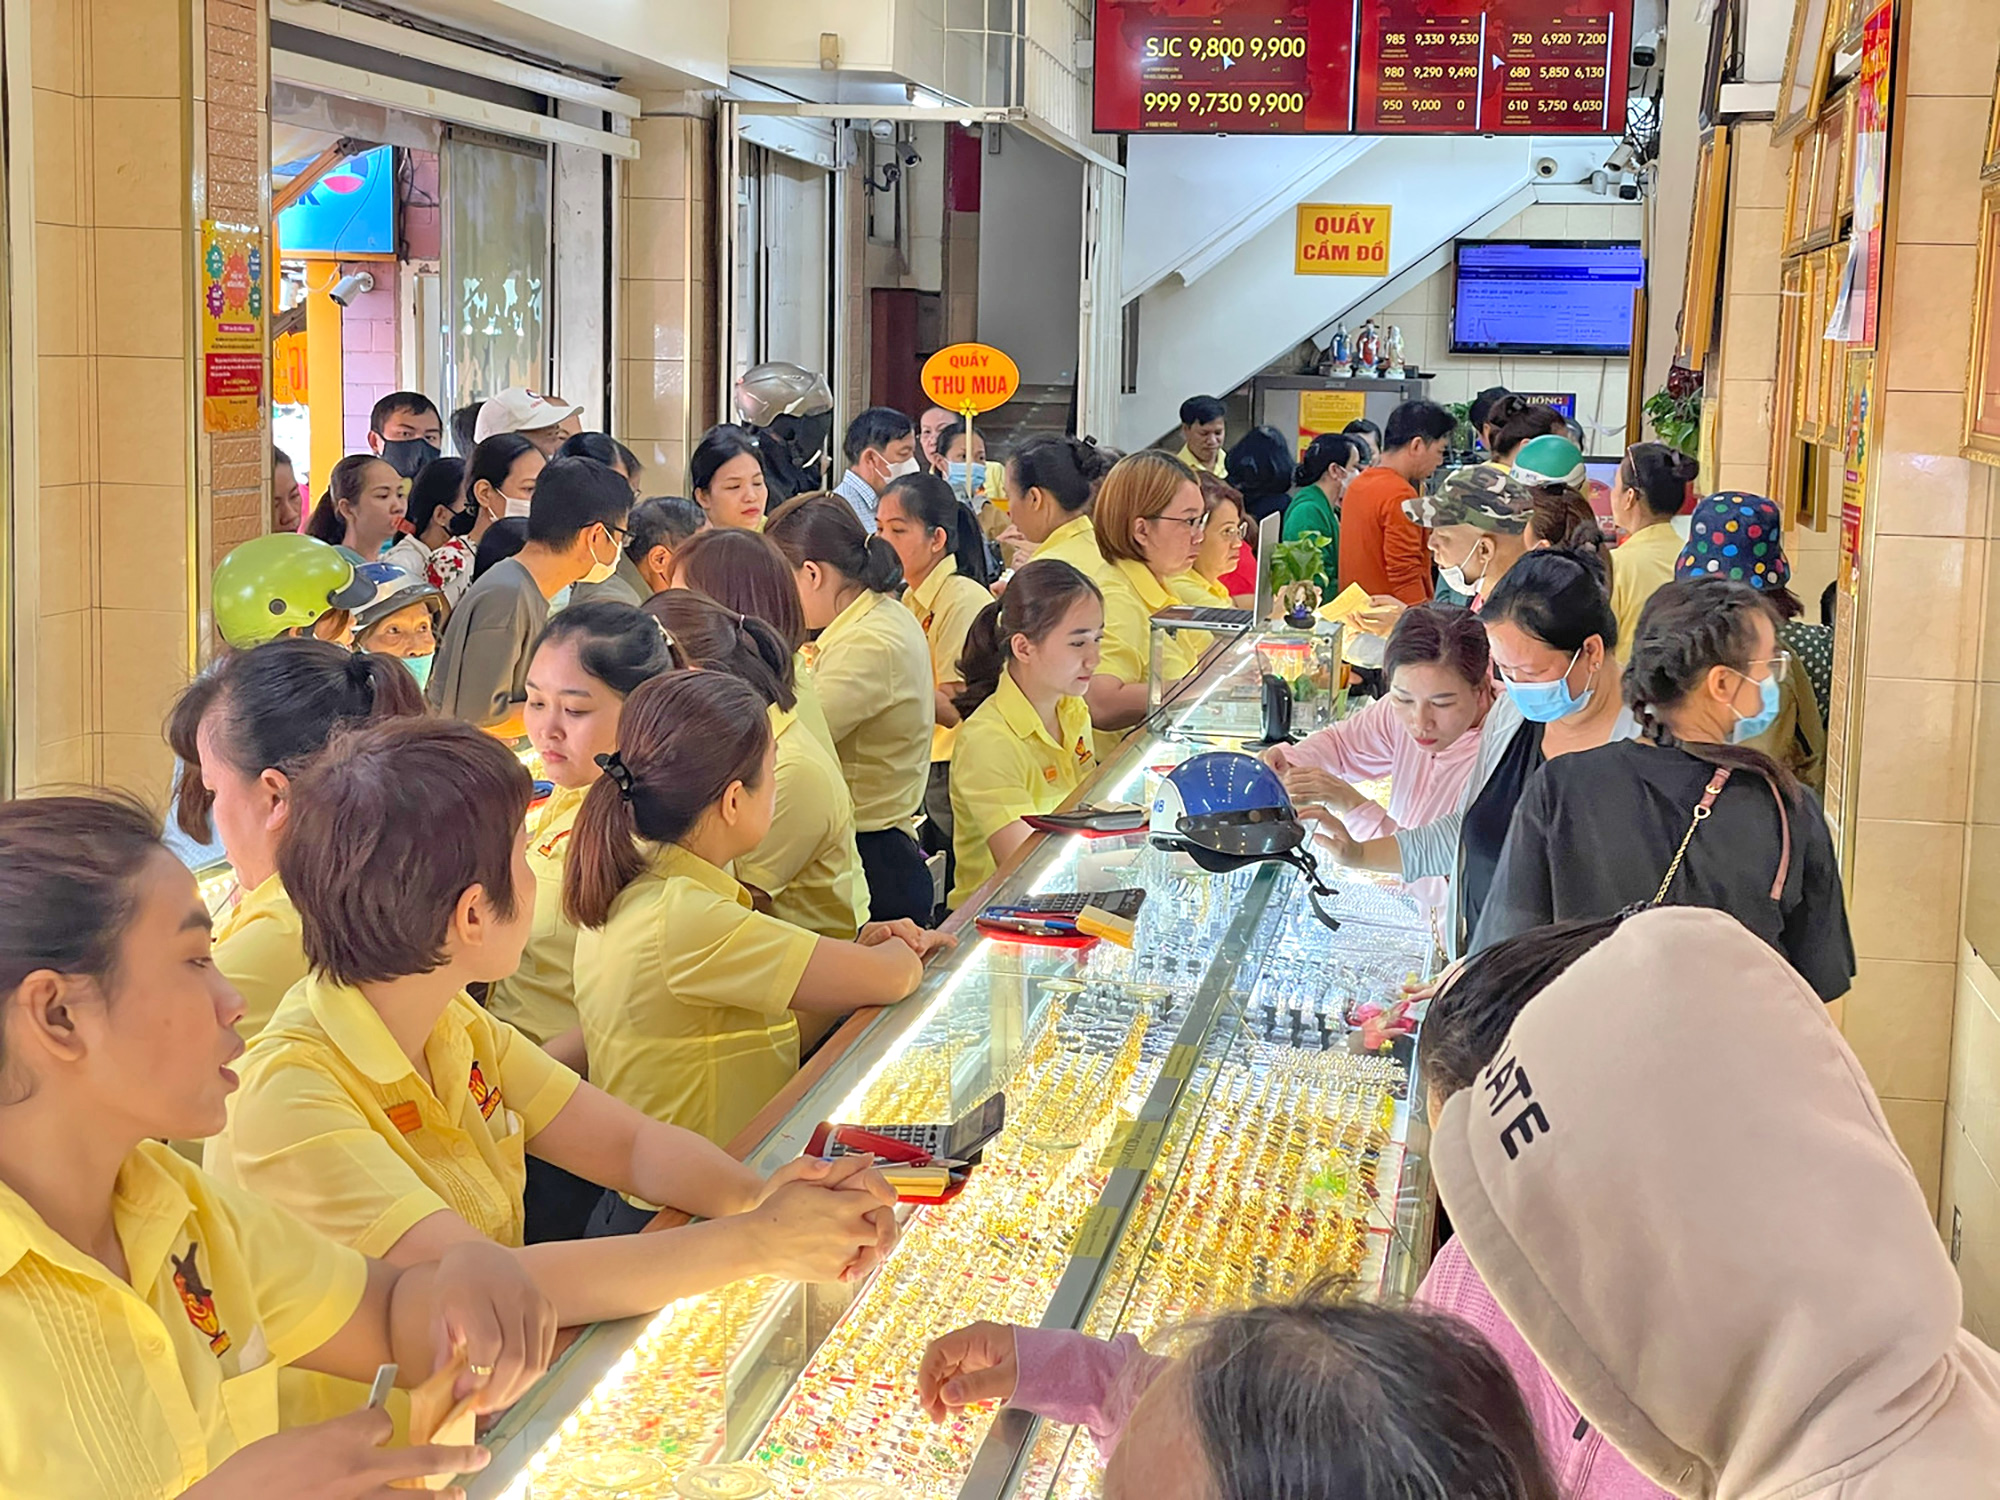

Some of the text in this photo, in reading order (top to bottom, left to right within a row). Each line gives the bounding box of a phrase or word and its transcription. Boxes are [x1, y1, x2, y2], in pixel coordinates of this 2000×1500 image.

[1385, 33, 1480, 46] 985 9,330 9,530
[1511, 33, 1607, 46] 750 6,920 7,200
[1144, 37, 1306, 61] SJC 9,800 9,900
[1384, 66, 1478, 80] 980 9,290 9,490
[1509, 66, 1605, 80] 680 5,850 6,130
[1143, 92, 1304, 116] 999 9,730 9,900
[1382, 100, 1465, 113] 950 9,000 0
[1507, 100, 1603, 113] 610 5,750 6,030
[932, 375, 1007, 395] THU MUA
